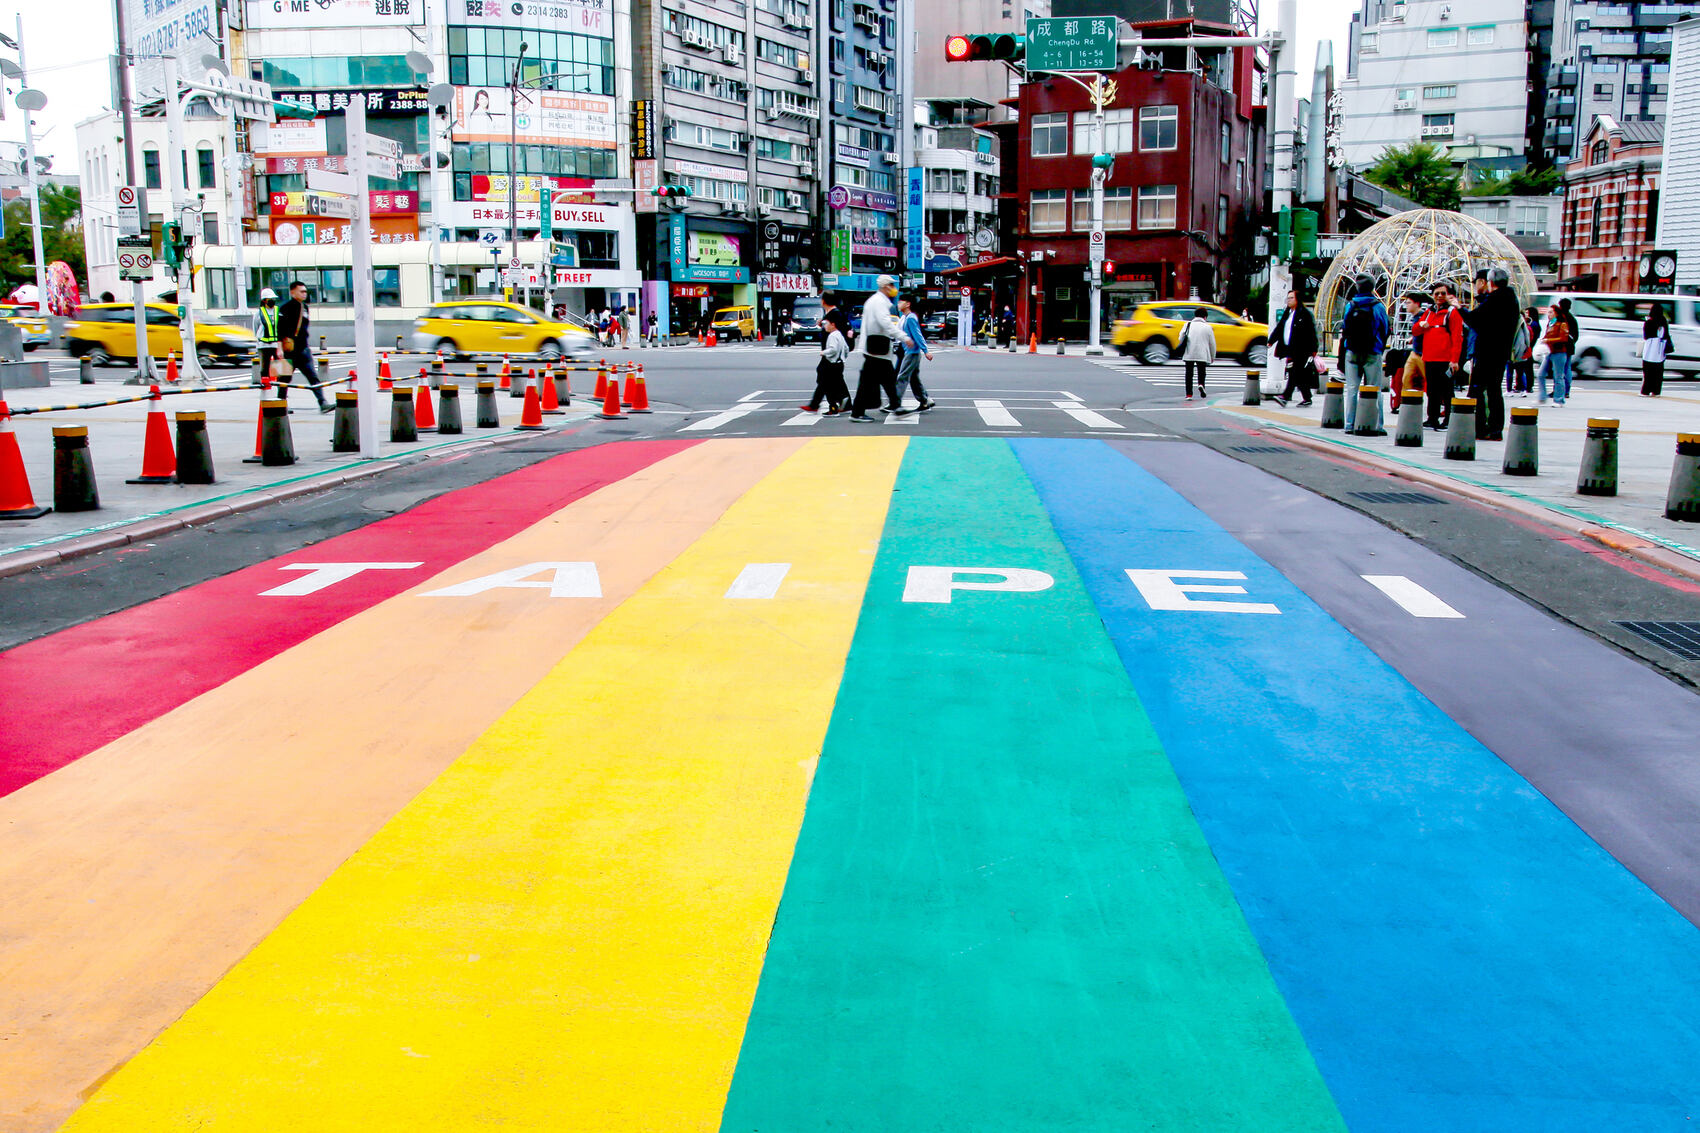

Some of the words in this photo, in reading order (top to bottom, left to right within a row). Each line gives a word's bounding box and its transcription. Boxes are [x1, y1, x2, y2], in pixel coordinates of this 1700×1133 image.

[273, 0, 311, 13] GAME
[527, 5, 548, 16] 2314
[549, 7, 568, 19] 2383
[1036, 20, 1106, 36] 成都路
[1048, 39, 1080, 47] ChengDu
[273, 195, 288, 206] 3F
[554, 209, 578, 222] BUY
[582, 210, 606, 223] SELL
[556, 273, 593, 283] TREET
[257, 561, 1467, 620] TAIPEI
